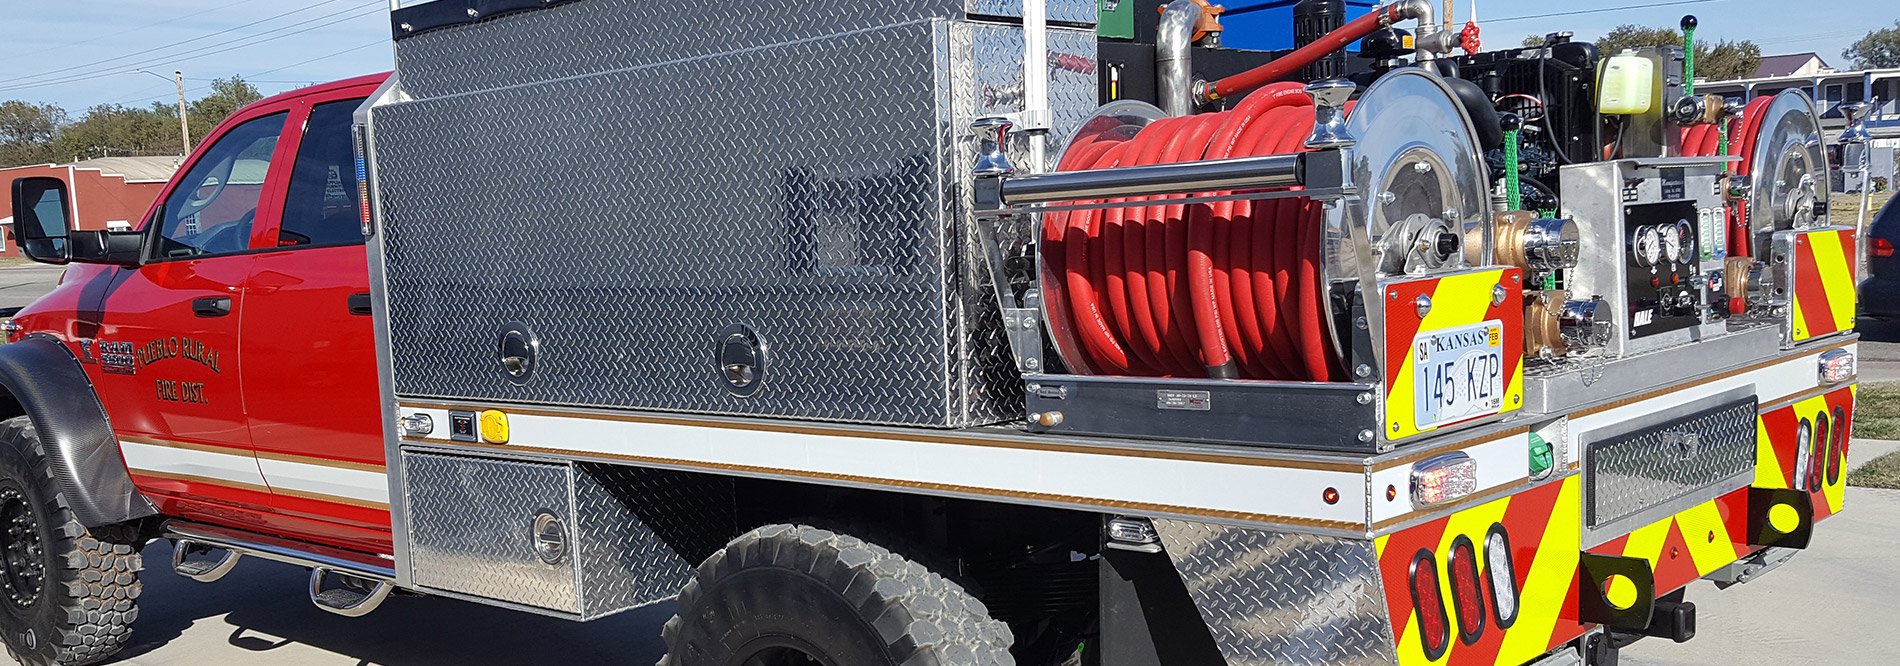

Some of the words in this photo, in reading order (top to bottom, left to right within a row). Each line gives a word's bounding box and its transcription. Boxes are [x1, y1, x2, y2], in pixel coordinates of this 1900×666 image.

[1234, 125, 1243, 139] MADE
[1097, 318, 1106, 331] MADE
[1633, 309, 1654, 328] HALE
[1217, 328, 1227, 353] BOOSTER
[1436, 331, 1483, 352] KANSAS
[1489, 332, 1498, 341] FEB
[99, 340, 134, 354] RAM
[136, 336, 179, 370] PUEBLO
[182, 336, 221, 374] RURAL
[1419, 342, 1429, 361] SA
[100, 353, 135, 367] 5500
[1423, 361, 1455, 411] 145
[1467, 353, 1499, 401] KZP
[156, 379, 178, 402] FIRE
[181, 381, 209, 405] DIST.
